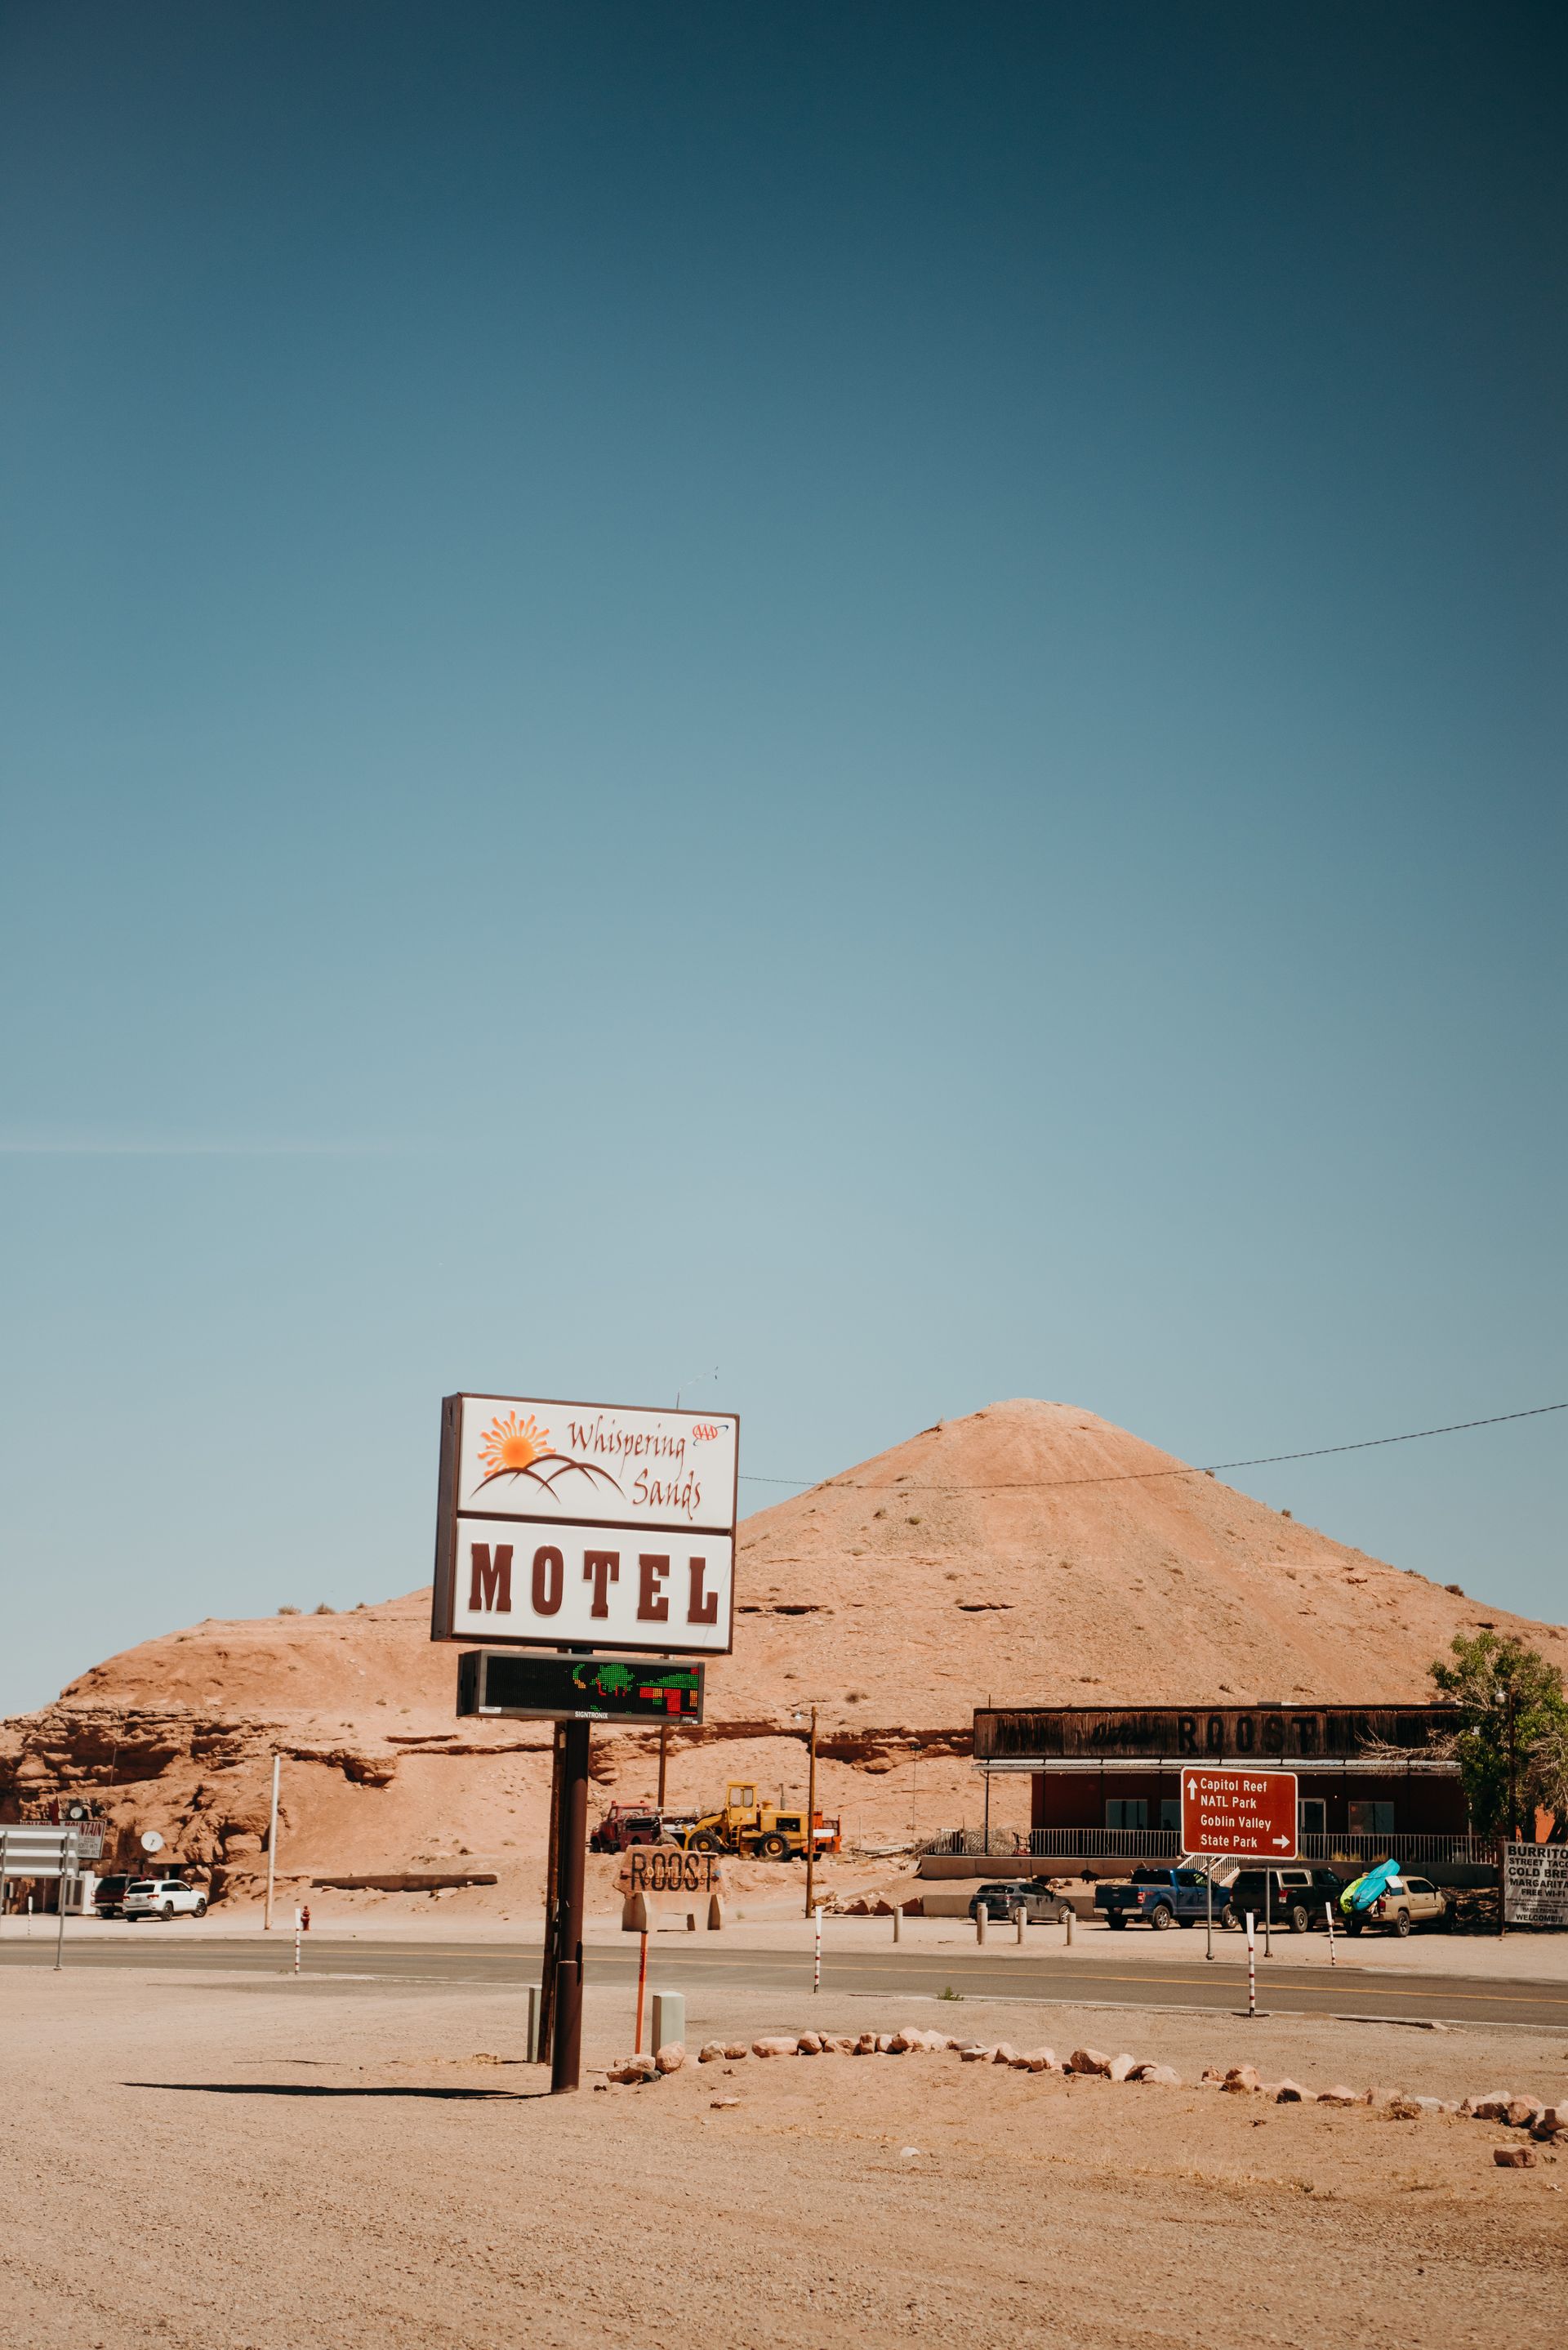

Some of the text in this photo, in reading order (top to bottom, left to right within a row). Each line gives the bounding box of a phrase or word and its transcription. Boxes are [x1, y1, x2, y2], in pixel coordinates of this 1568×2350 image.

[693, 1424, 717, 1441] AAA
[568, 1415, 686, 1482] Whispering
[632, 1468, 702, 1521] Sands
[468, 1541, 719, 1625] MOTEL
[574, 1710, 608, 1719] SIGNTRONIX
[1178, 1716, 1316, 1754] ROOST
[1200, 1777, 1267, 1792] Capitol Reef
[1200, 1795, 1257, 1809] NATL Park
[1200, 1814, 1272, 1832] Goblin Valley
[1200, 1834, 1258, 1848] State Park
[1508, 1846, 1568, 1859] BURRITO
[1509, 1857, 1544, 1866] STREET
[631, 1853, 717, 1893] ROOST
[1508, 1866, 1540, 1877] COLD
[1544, 1889, 1566, 1897] WI-FI
[1516, 1914, 1563, 1923] WELCOME!!!
